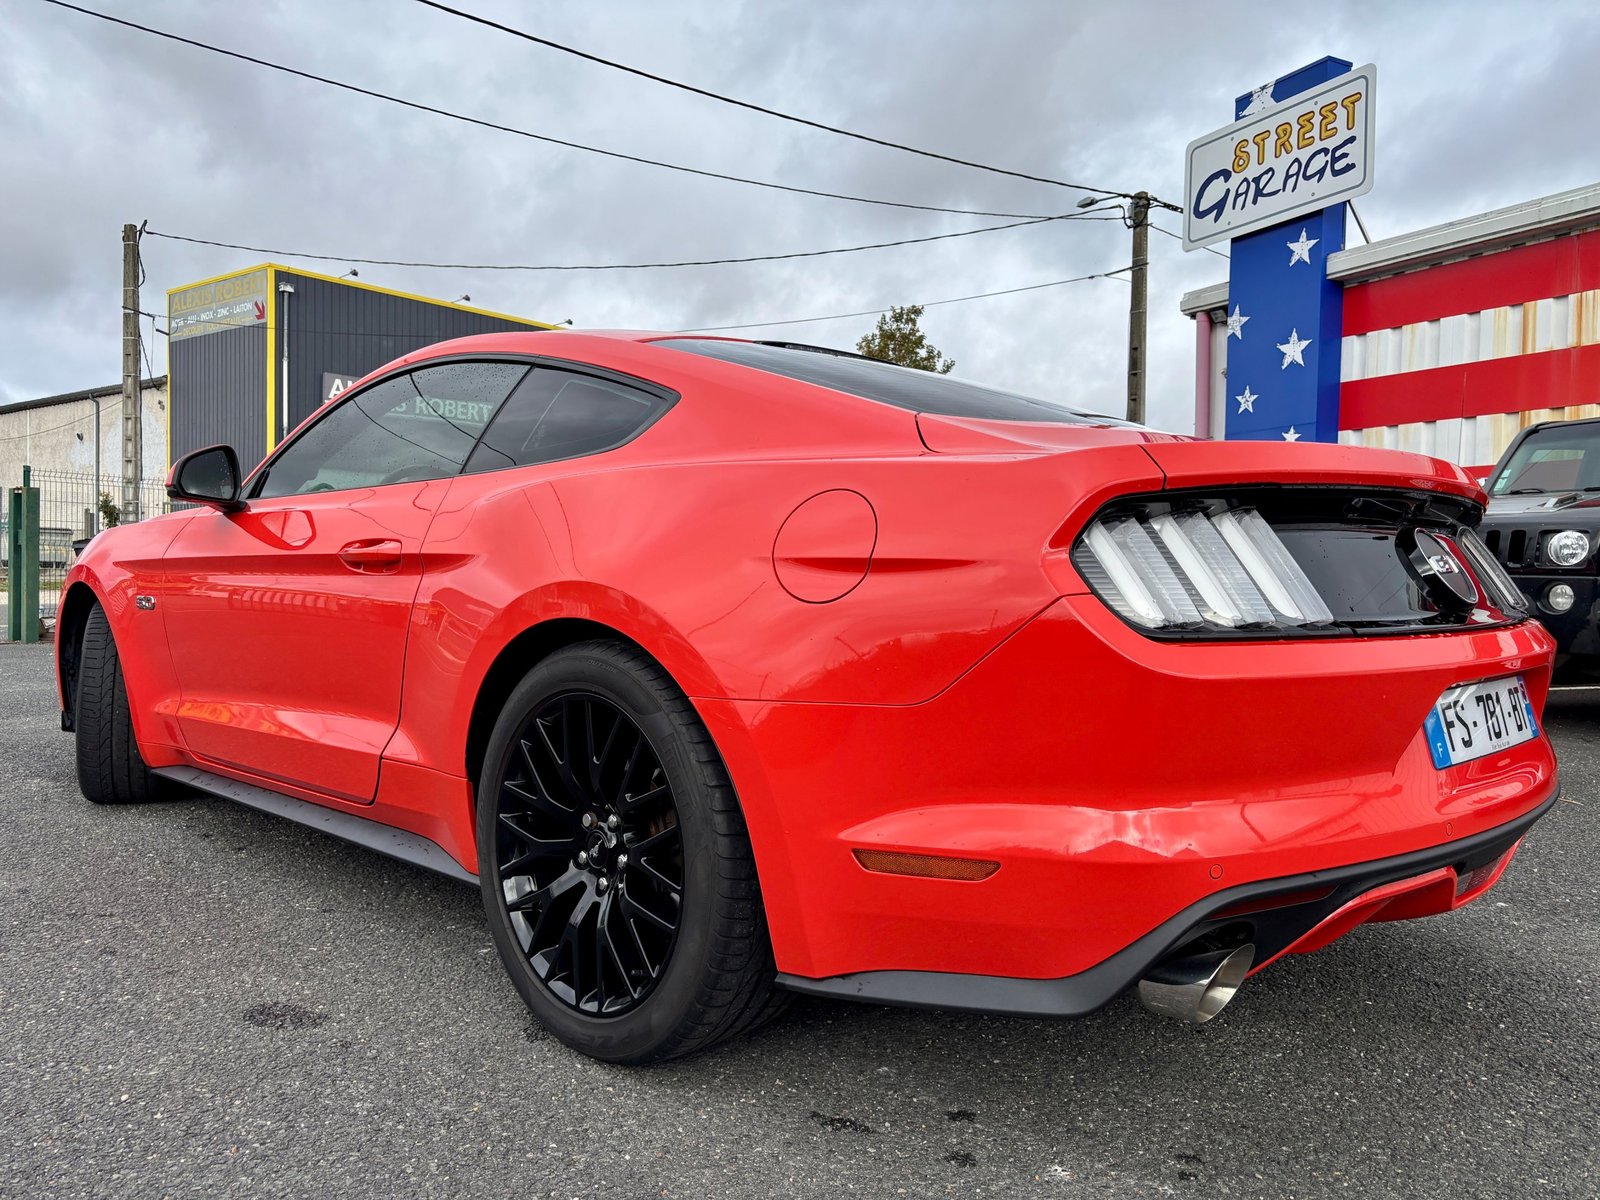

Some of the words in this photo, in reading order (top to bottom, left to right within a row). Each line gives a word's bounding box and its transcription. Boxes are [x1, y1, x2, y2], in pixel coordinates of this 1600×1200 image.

[1232, 92, 1362, 173] STREET
[1193, 136, 1357, 223] GARAGE
[172, 287, 212, 311] ALEXIS
[215, 274, 265, 300] ROBERT
[200, 311, 214, 320] INOX
[217, 306, 230, 317] ZINC
[233, 300, 253, 314] LAITON
[415, 396, 493, 422] ROBERT
